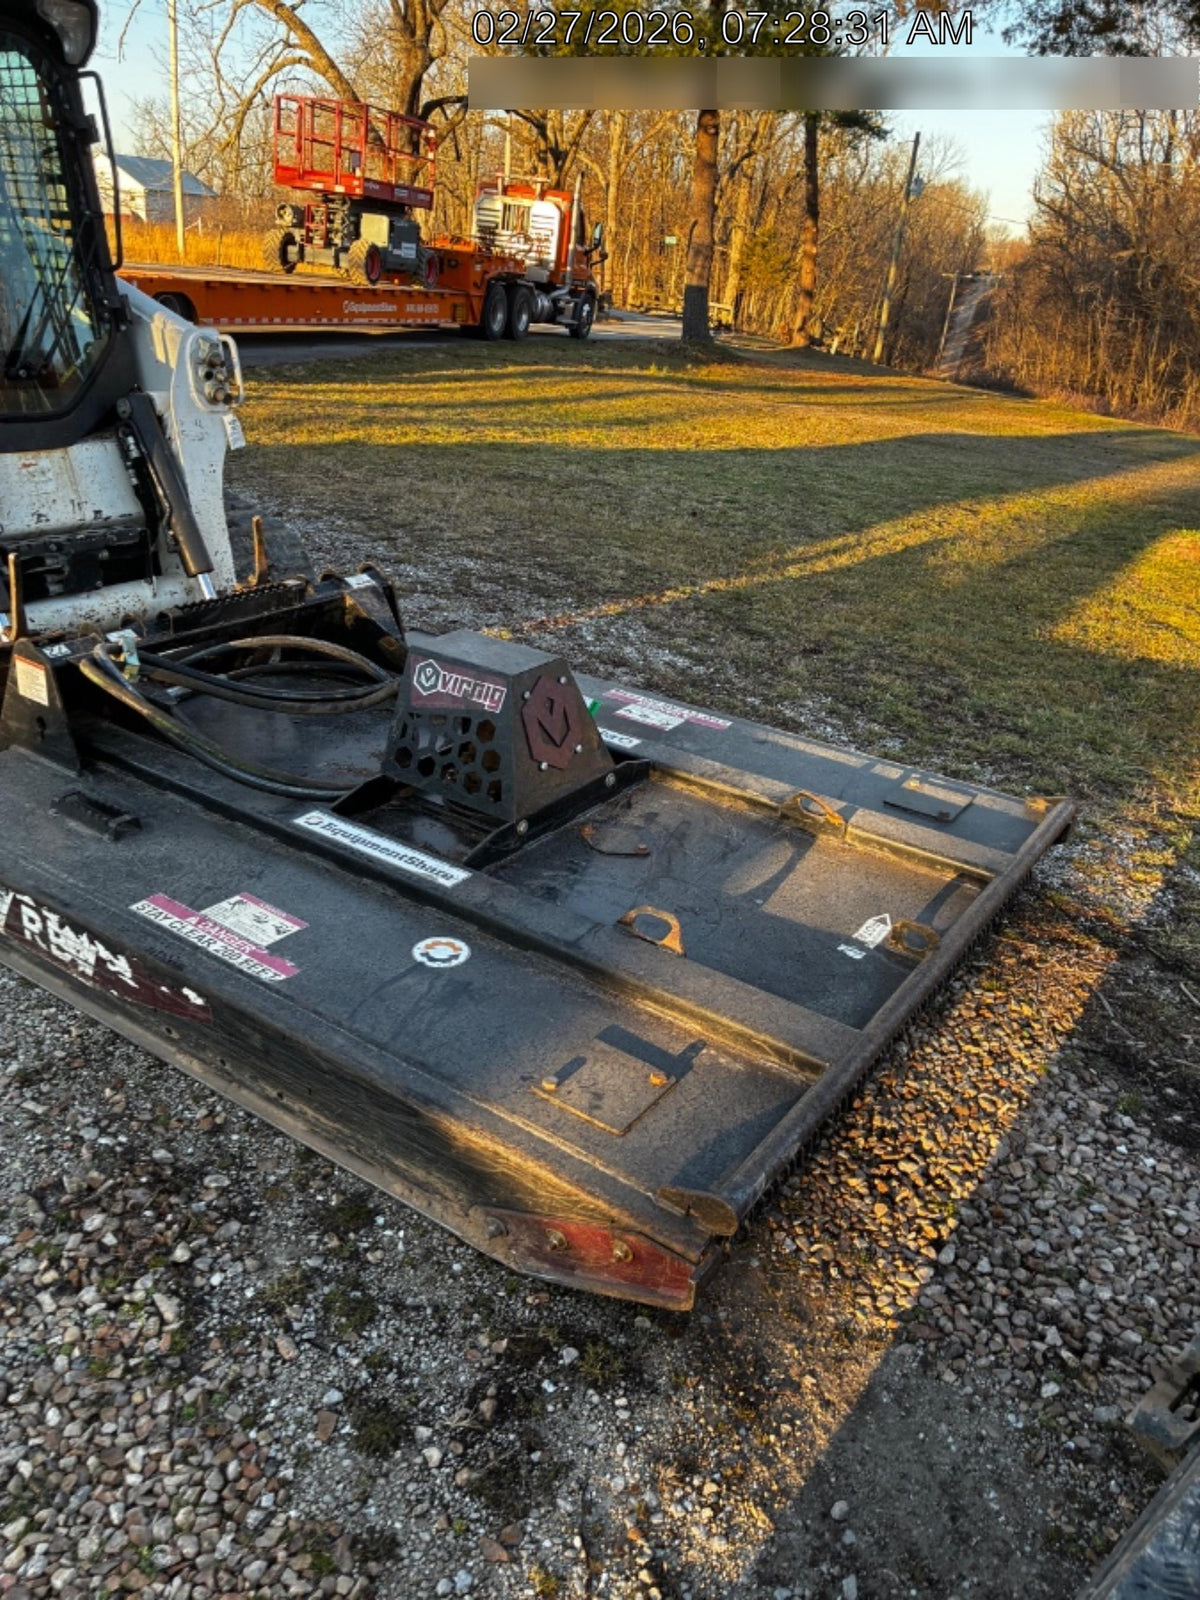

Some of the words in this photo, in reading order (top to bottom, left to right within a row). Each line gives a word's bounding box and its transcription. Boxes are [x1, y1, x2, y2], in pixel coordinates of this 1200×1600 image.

[320, 822, 455, 882] EquipmentShare
[135, 902, 172, 922] STAY
[169, 919, 217, 947] CLEAR
[214, 944, 242, 961] 200
[242, 957, 283, 980] FEET
[200, 918, 253, 952] DANGER
